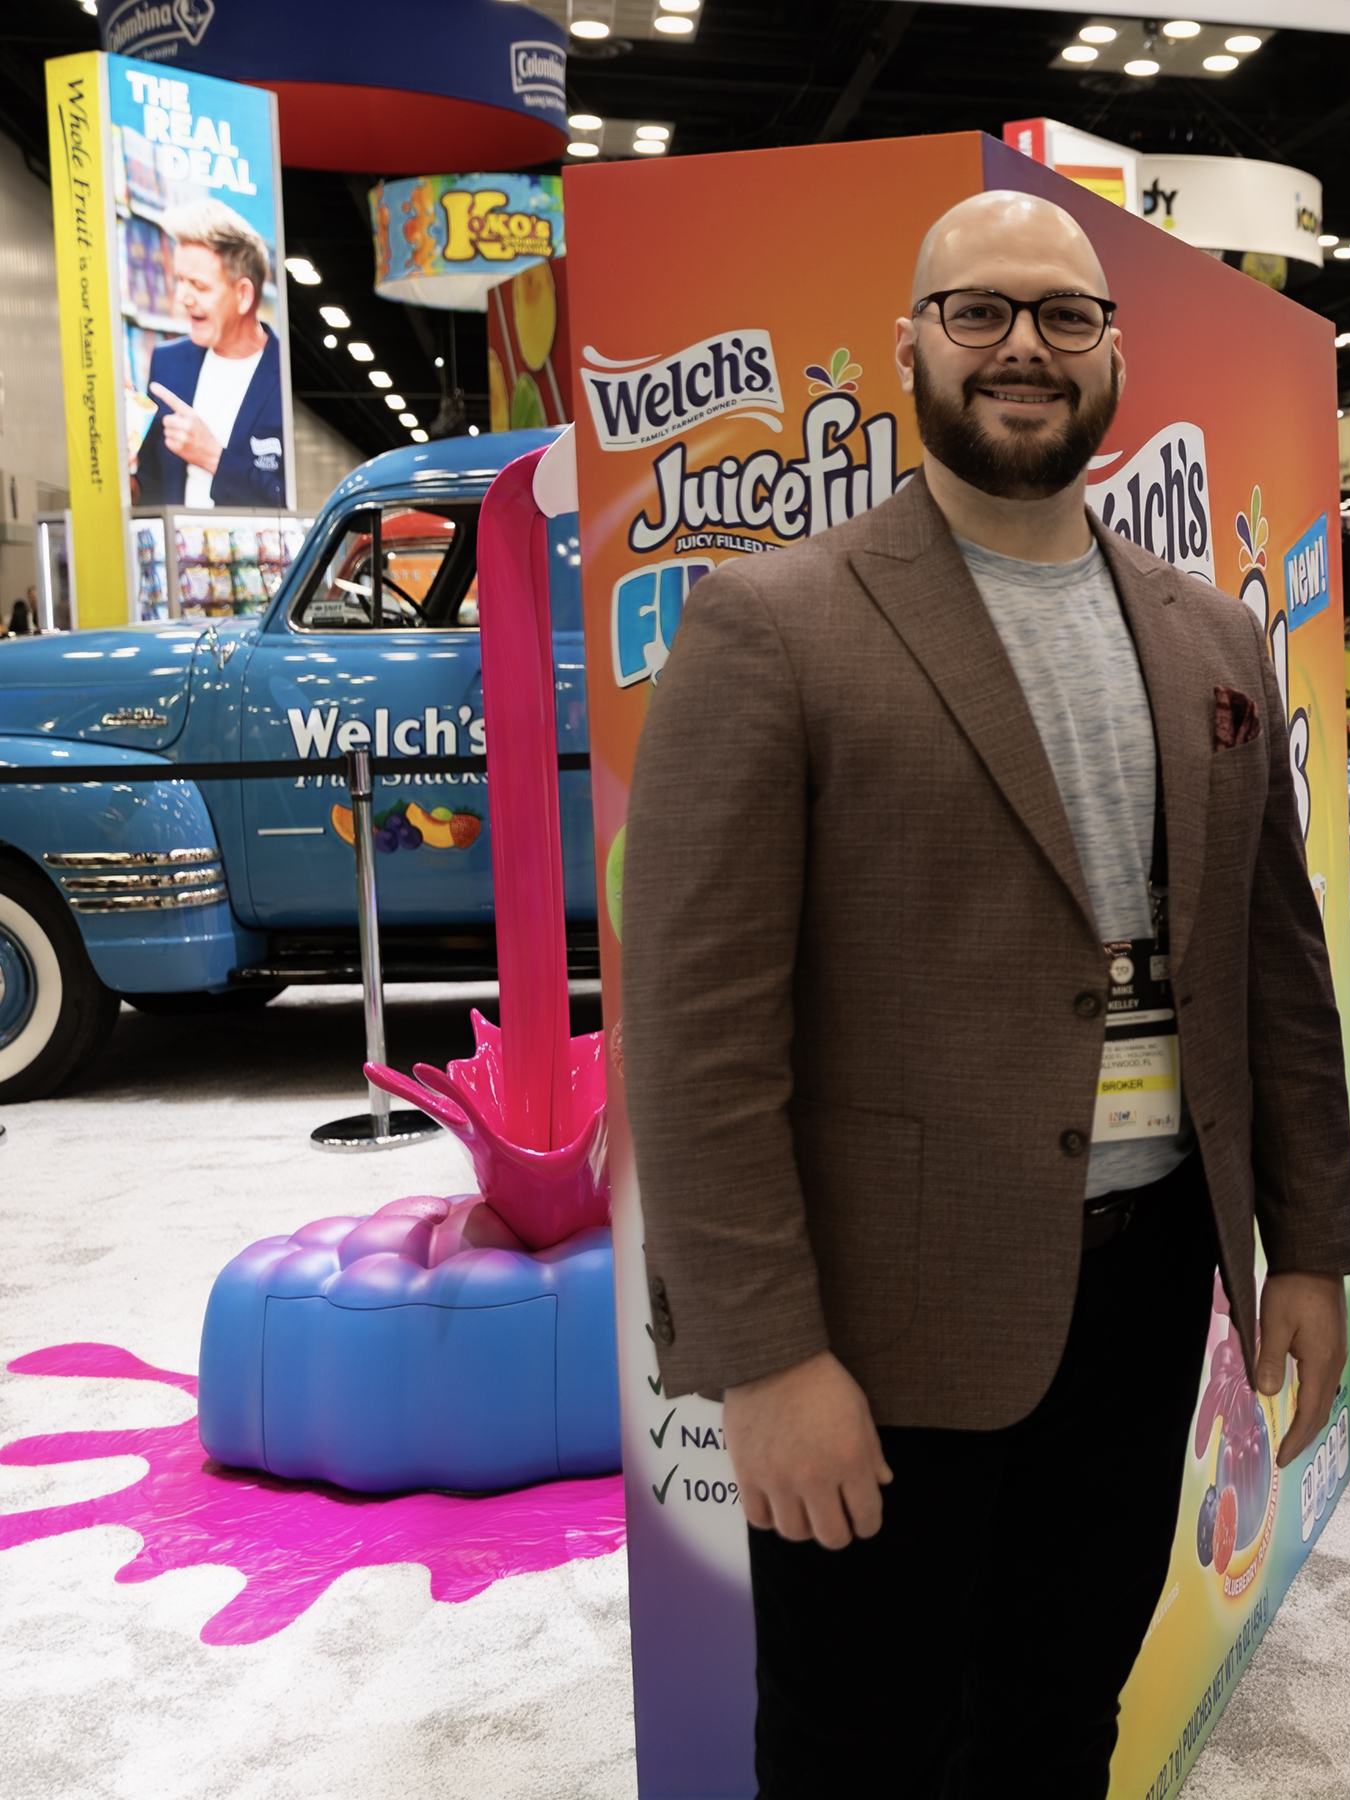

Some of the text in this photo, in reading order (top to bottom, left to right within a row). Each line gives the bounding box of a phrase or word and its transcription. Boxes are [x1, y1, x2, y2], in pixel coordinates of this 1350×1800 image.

[125, 69, 191, 114] THE
[67, 78, 92, 169] Whole
[143, 103, 240, 158] REAL
[154, 144, 258, 196] DEAL
[73, 177, 94, 250] Fruit
[79, 277, 91, 313] our
[82, 316, 96, 369] Main
[591, 337, 771, 437] Welch's
[640, 398, 738, 444] FAMILY FARMER OWNED
[675, 533, 713, 553] JUICY
[287, 705, 488, 759] Welch's
[1108, 998, 1140, 1011] KELLEY
[1101, 1079, 1144, 1092] BROKER
[1224, 1556, 1258, 1597] BLUEBERRY
[1182, 1685, 1213, 1760] POUCHES
[1213, 1662, 1224, 1708] NET
